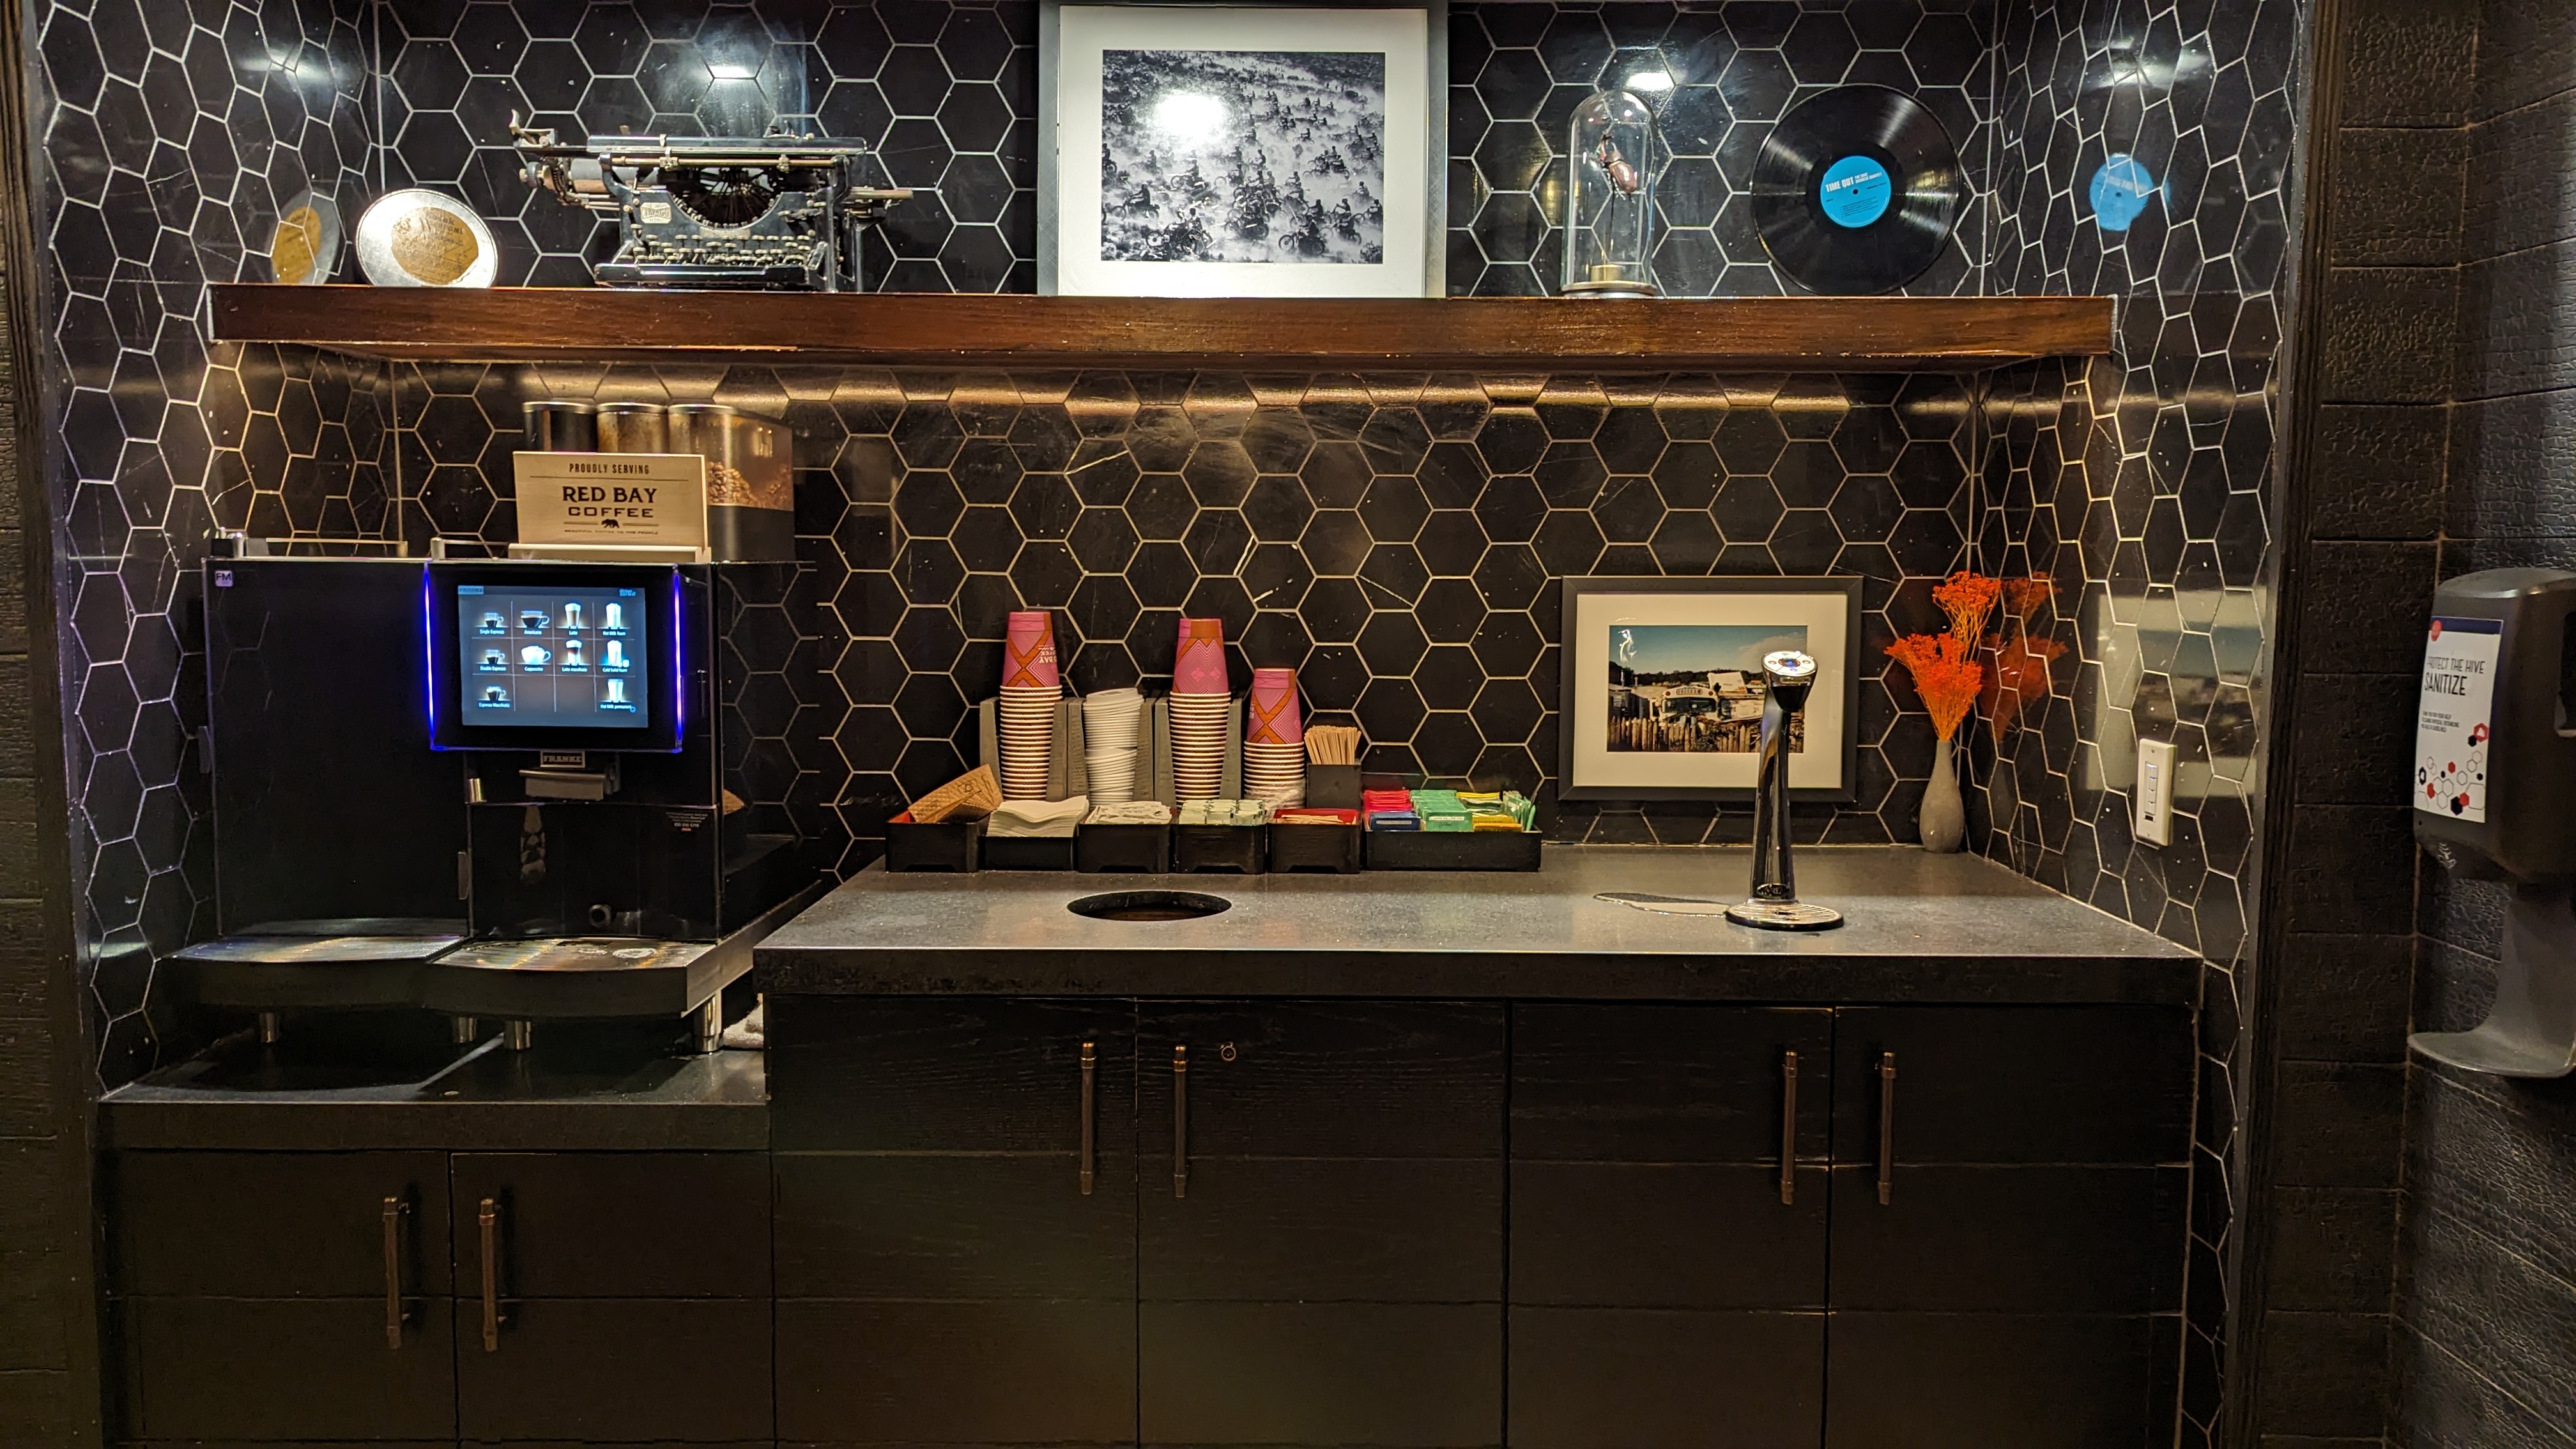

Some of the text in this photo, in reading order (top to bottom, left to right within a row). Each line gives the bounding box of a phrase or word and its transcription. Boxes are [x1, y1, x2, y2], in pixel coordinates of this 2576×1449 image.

[1825, 181, 1841, 192] TIME
[1841, 176, 1854, 188] OUT
[569, 463, 650, 475] PROUDLY SERVING
[562, 486, 657, 503] RED BAY
[569, 507, 654, 518] COFFEE
[2451, 658, 2464, 672] THE
[2465, 659, 2485, 675] HIVE
[2424, 672, 2467, 696] SANITIZE
